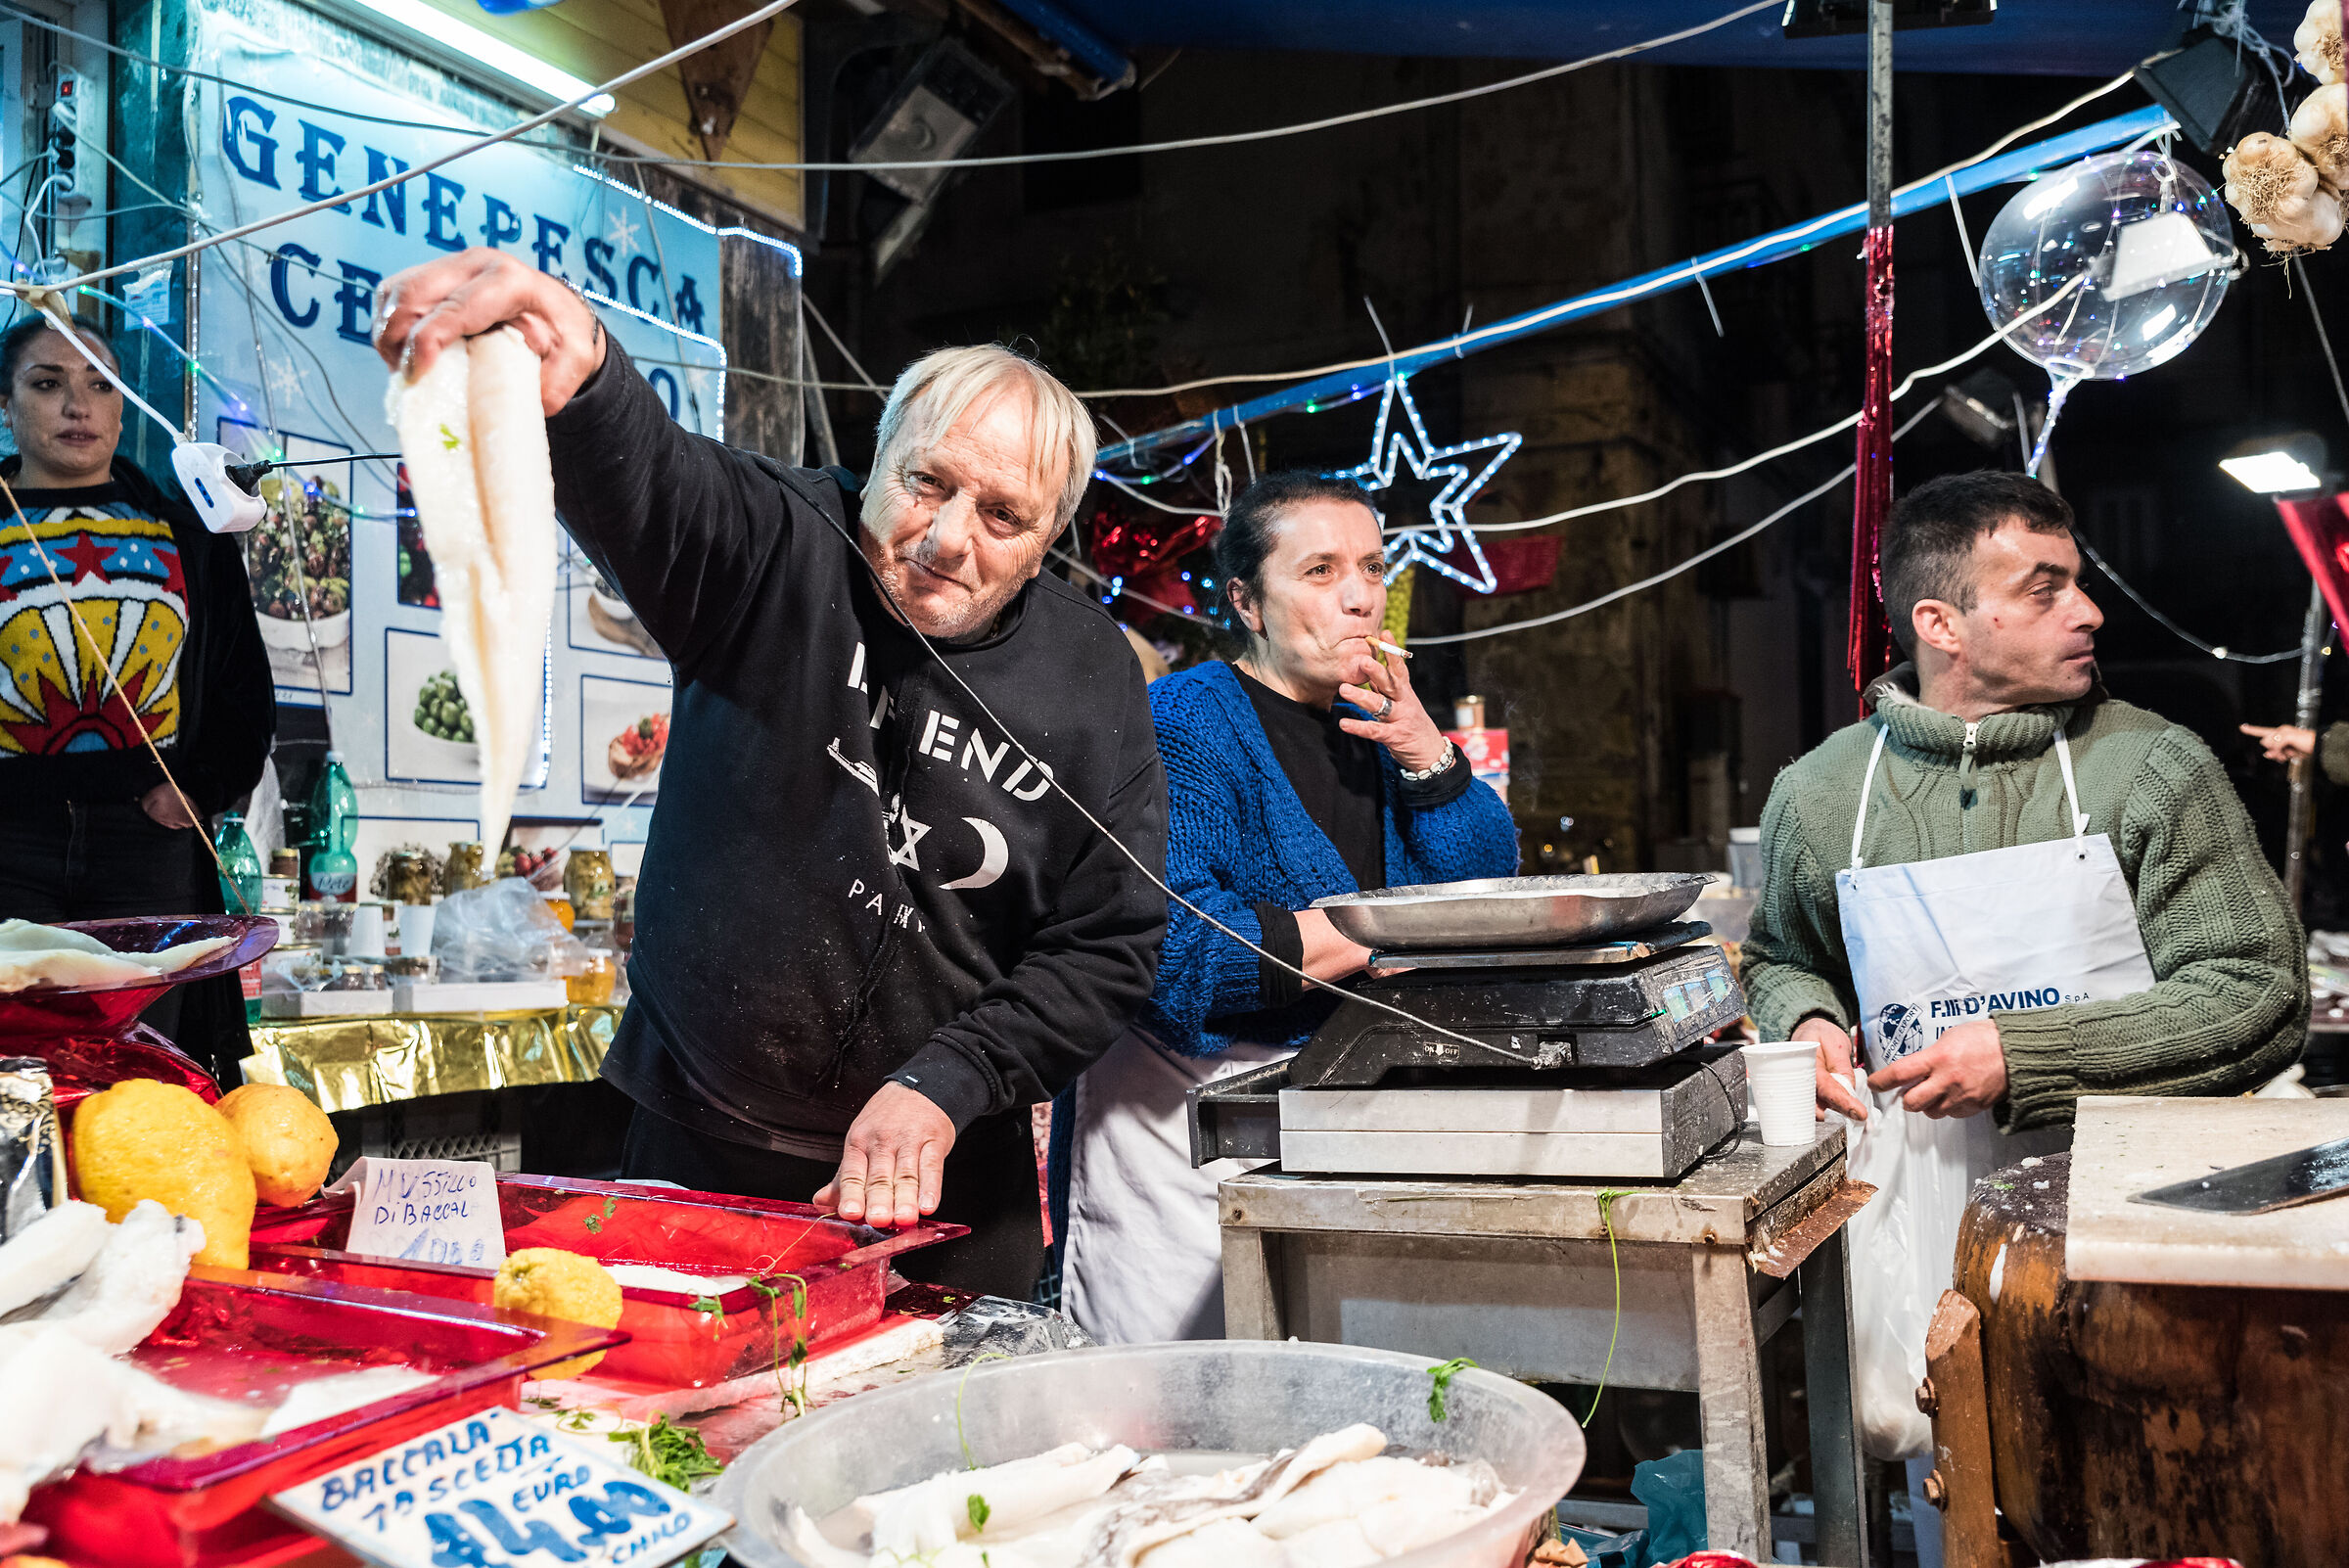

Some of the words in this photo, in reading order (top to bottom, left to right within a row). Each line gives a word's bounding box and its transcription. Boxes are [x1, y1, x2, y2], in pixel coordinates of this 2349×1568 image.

[222, 95, 708, 337] GENEPESCA
[1445, 1047, 1458, 1056] OFF
[512, 1464, 592, 1513] EURO
